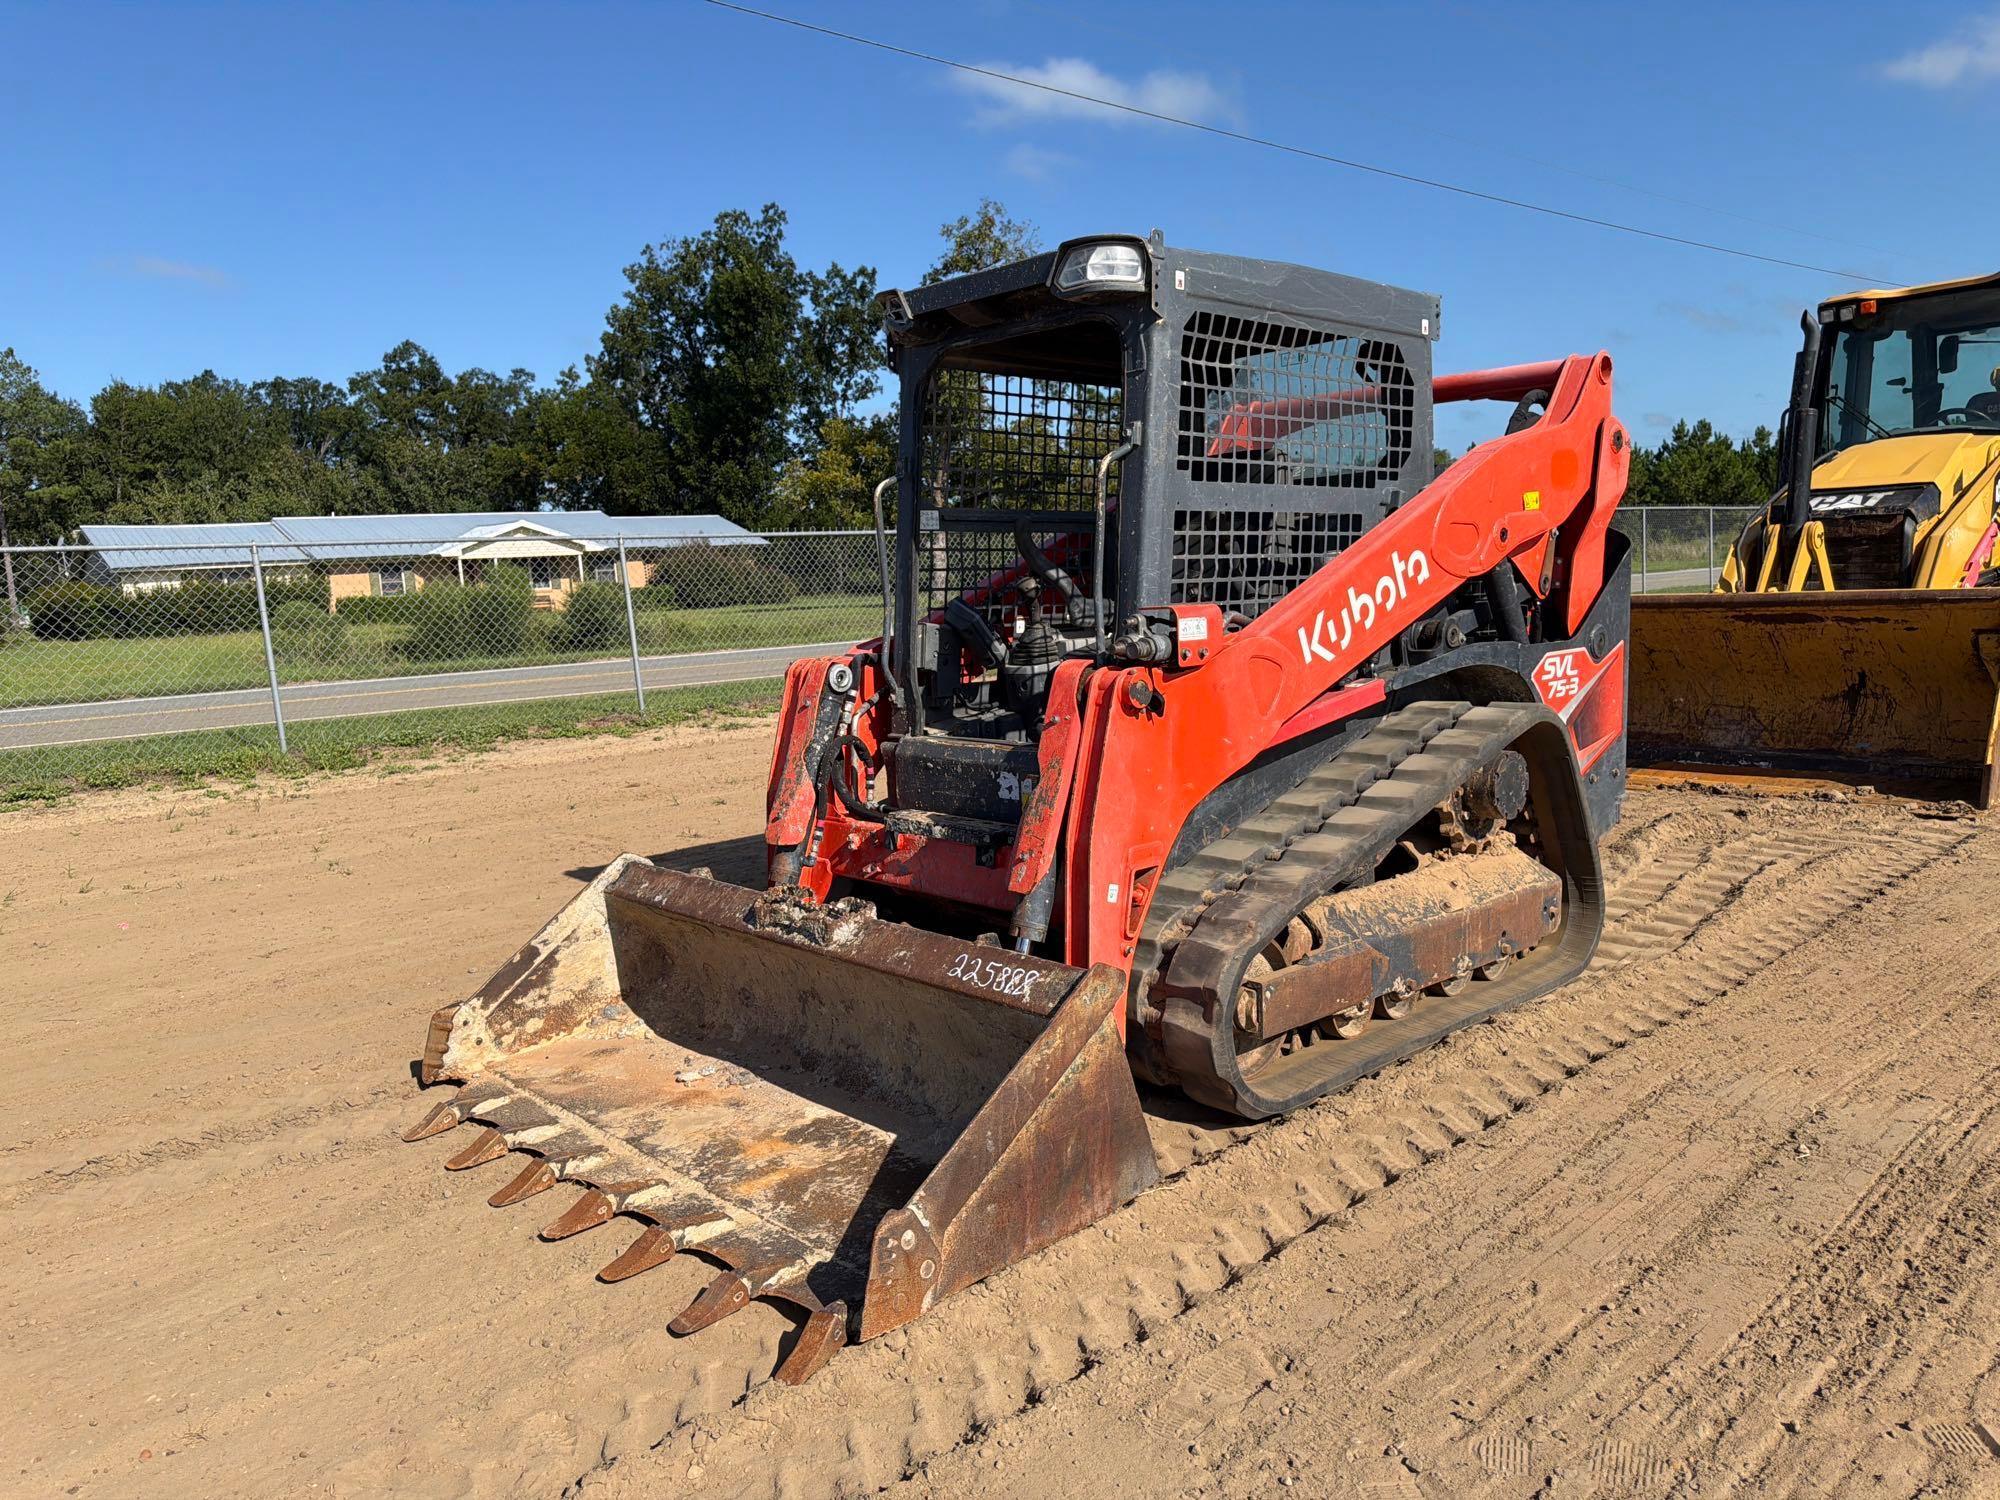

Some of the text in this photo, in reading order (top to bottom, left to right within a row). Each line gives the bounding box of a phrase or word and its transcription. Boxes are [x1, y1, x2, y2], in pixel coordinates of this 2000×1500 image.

[1809, 491, 1895, 511] CAT
[1298, 549, 1430, 665] Kubota
[1541, 654, 1578, 681] SVL
[1547, 677, 1579, 699] 75-3
[947, 953, 1040, 996] 225888
